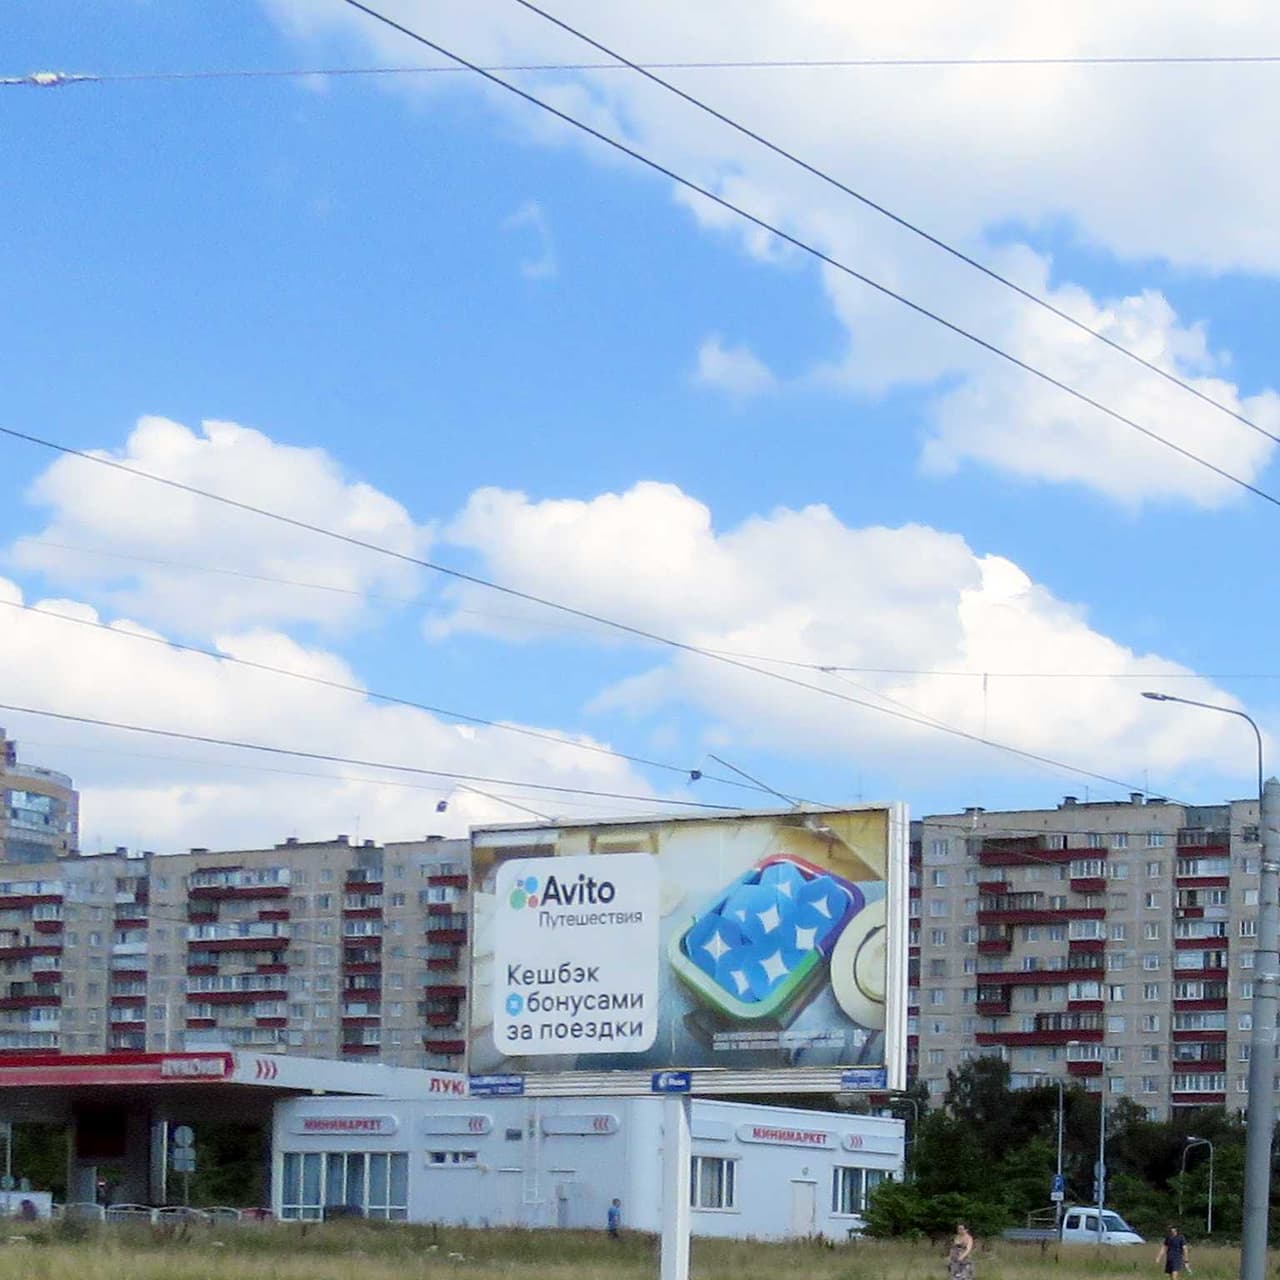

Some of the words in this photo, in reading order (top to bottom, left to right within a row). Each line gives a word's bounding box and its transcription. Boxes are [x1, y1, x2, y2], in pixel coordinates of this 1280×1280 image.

[540, 873, 615, 907] Avito
[539, 911, 643, 930] Путешествия
[507, 962, 600, 986] Кешбэк
[527, 991, 644, 1016] бонусами
[506, 1024, 533, 1040] за
[540, 1021, 644, 1041] поездки
[429, 1078, 464, 1095] ЛУК
[752, 1127, 828, 1145] МИНИМАРКЕТ
